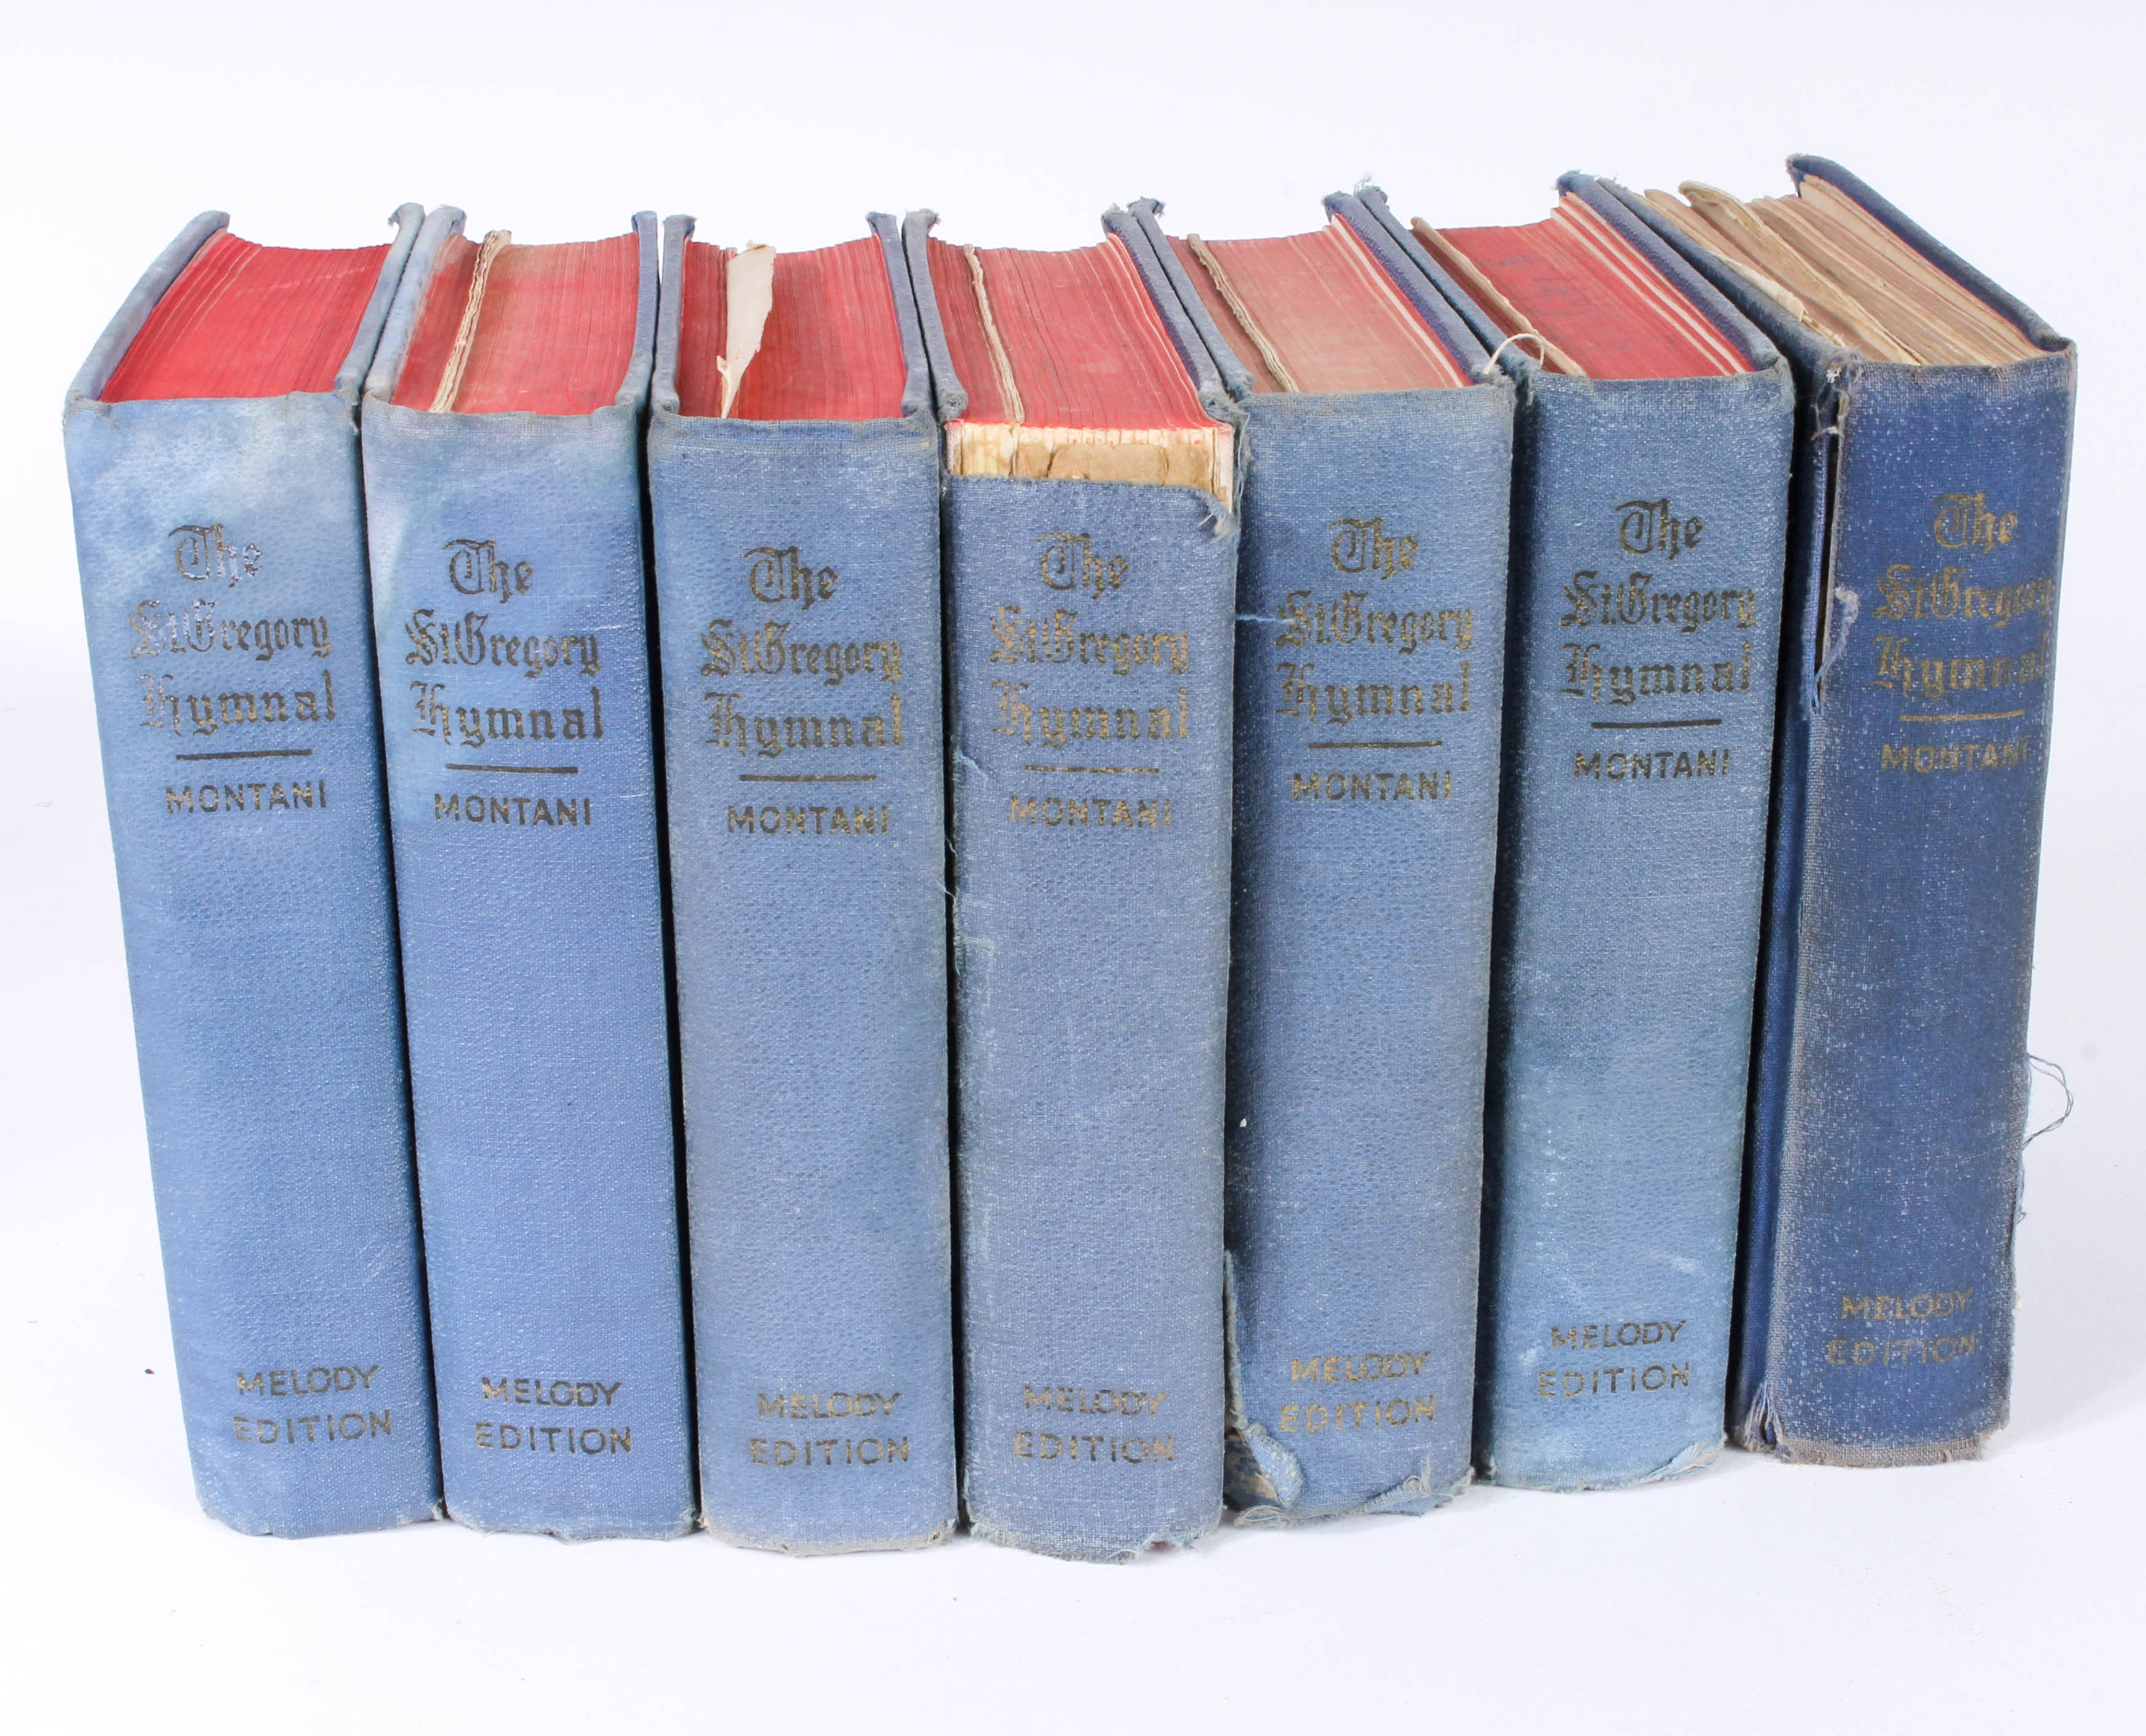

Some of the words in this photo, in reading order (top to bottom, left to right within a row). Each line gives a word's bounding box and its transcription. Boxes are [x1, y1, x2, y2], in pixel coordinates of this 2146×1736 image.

[1615, 497, 1704, 561] The
[1932, 492, 2019, 556] The
[167, 522, 263, 588] The
[1035, 531, 1130, 600] The
[1326, 516, 1421, 581] The
[442, 538, 535, 603] The
[743, 545, 839, 610] The
[1558, 640, 1751, 706] Hymnal
[134, 668, 337, 739] Hymnal
[1274, 659, 1472, 727] Hymnal
[410, 680, 604, 750] Hymnal
[703, 691, 902, 758] Hymnal
[992, 679, 1189, 751] Hymnal
[1573, 749, 1730, 781] MONTANI
[1881, 737, 2029, 773] MONTANI
[164, 780, 327, 814] MONTANI
[1291, 770, 1453, 802] MONTANI
[434, 793, 591, 827] MONTANI
[727, 805, 890, 836] MONTANI
[1008, 794, 1171, 829] MONTANI
[1841, 1286, 1974, 1320] MELODY
[1550, 1319, 1688, 1352] MELODY
[1826, 1329, 1977, 1366] EDITION
[236, 1364, 380, 1397] MELODY
[1290, 1350, 1432, 1385] MELODY
[1538, 1361, 1692, 1398] EDITION
[482, 1376, 623, 1408] MELODY
[757, 1391, 902, 1420] MELODY
[1024, 1384, 1168, 1417] MELODY
[233, 1410, 392, 1444] EDITION
[1280, 1395, 1436, 1434] EDITION
[476, 1423, 632, 1455] EDITION
[749, 1436, 910, 1466] EDITION
[1015, 1431, 1175, 1463] EDITION
